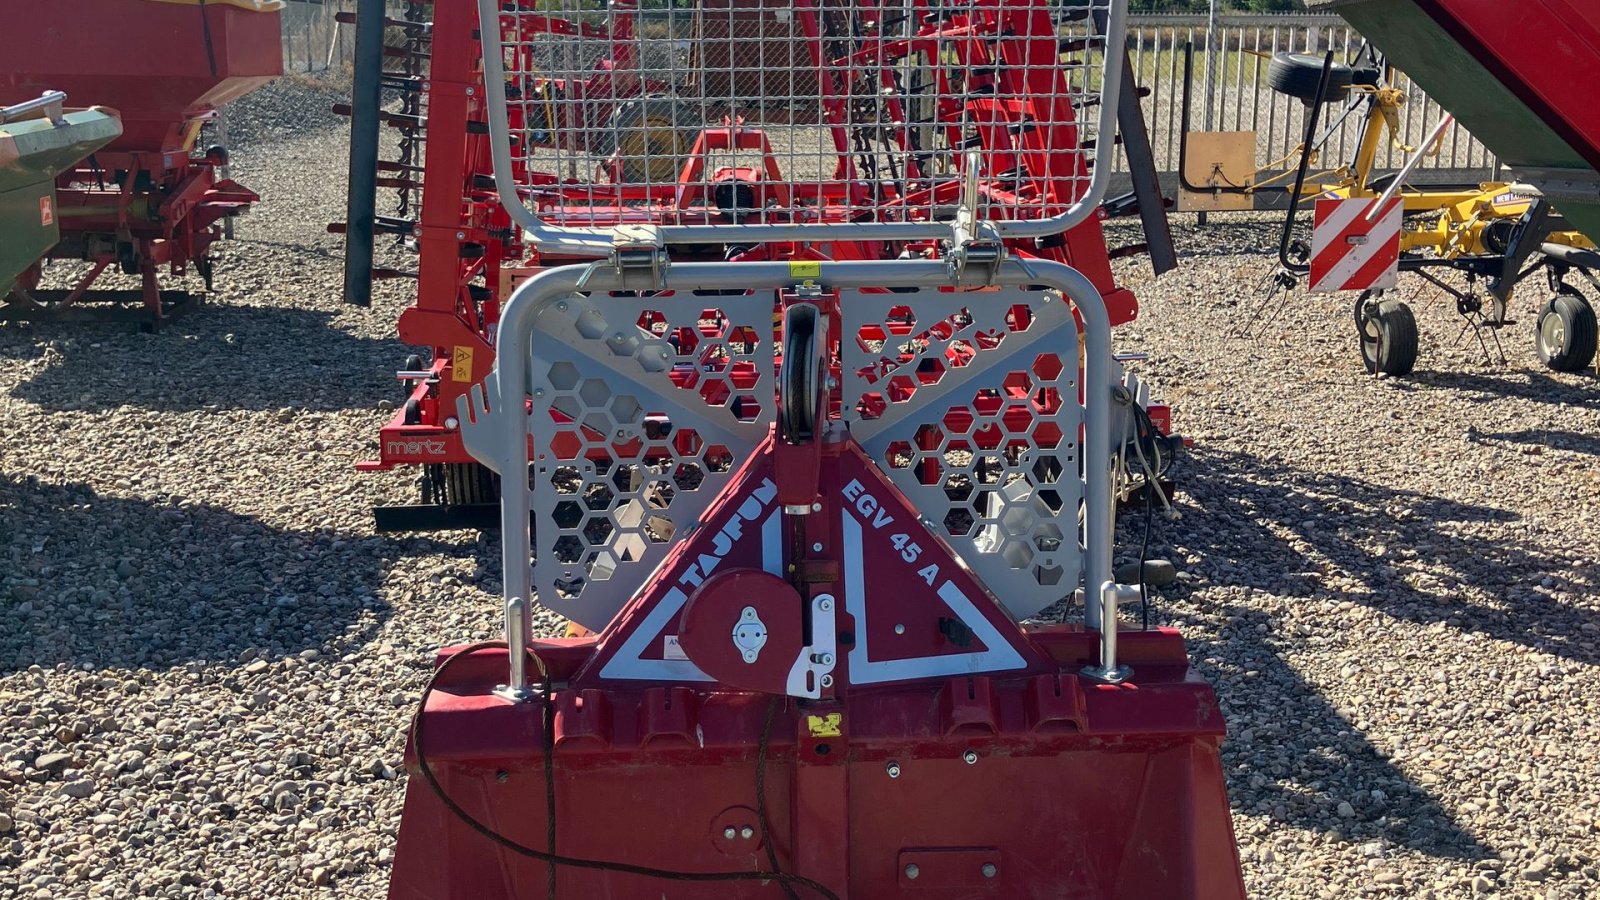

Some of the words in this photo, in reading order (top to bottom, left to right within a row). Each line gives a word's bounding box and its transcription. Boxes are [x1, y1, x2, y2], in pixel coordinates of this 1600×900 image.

[1496, 193, 1510, 203] NEW
[387, 439, 446, 455] mertz
[678, 476, 778, 588] TAJFUN
[841, 478, 895, 529] EGV
[889, 532, 923, 564] 45
[916, 562, 940, 587] A
